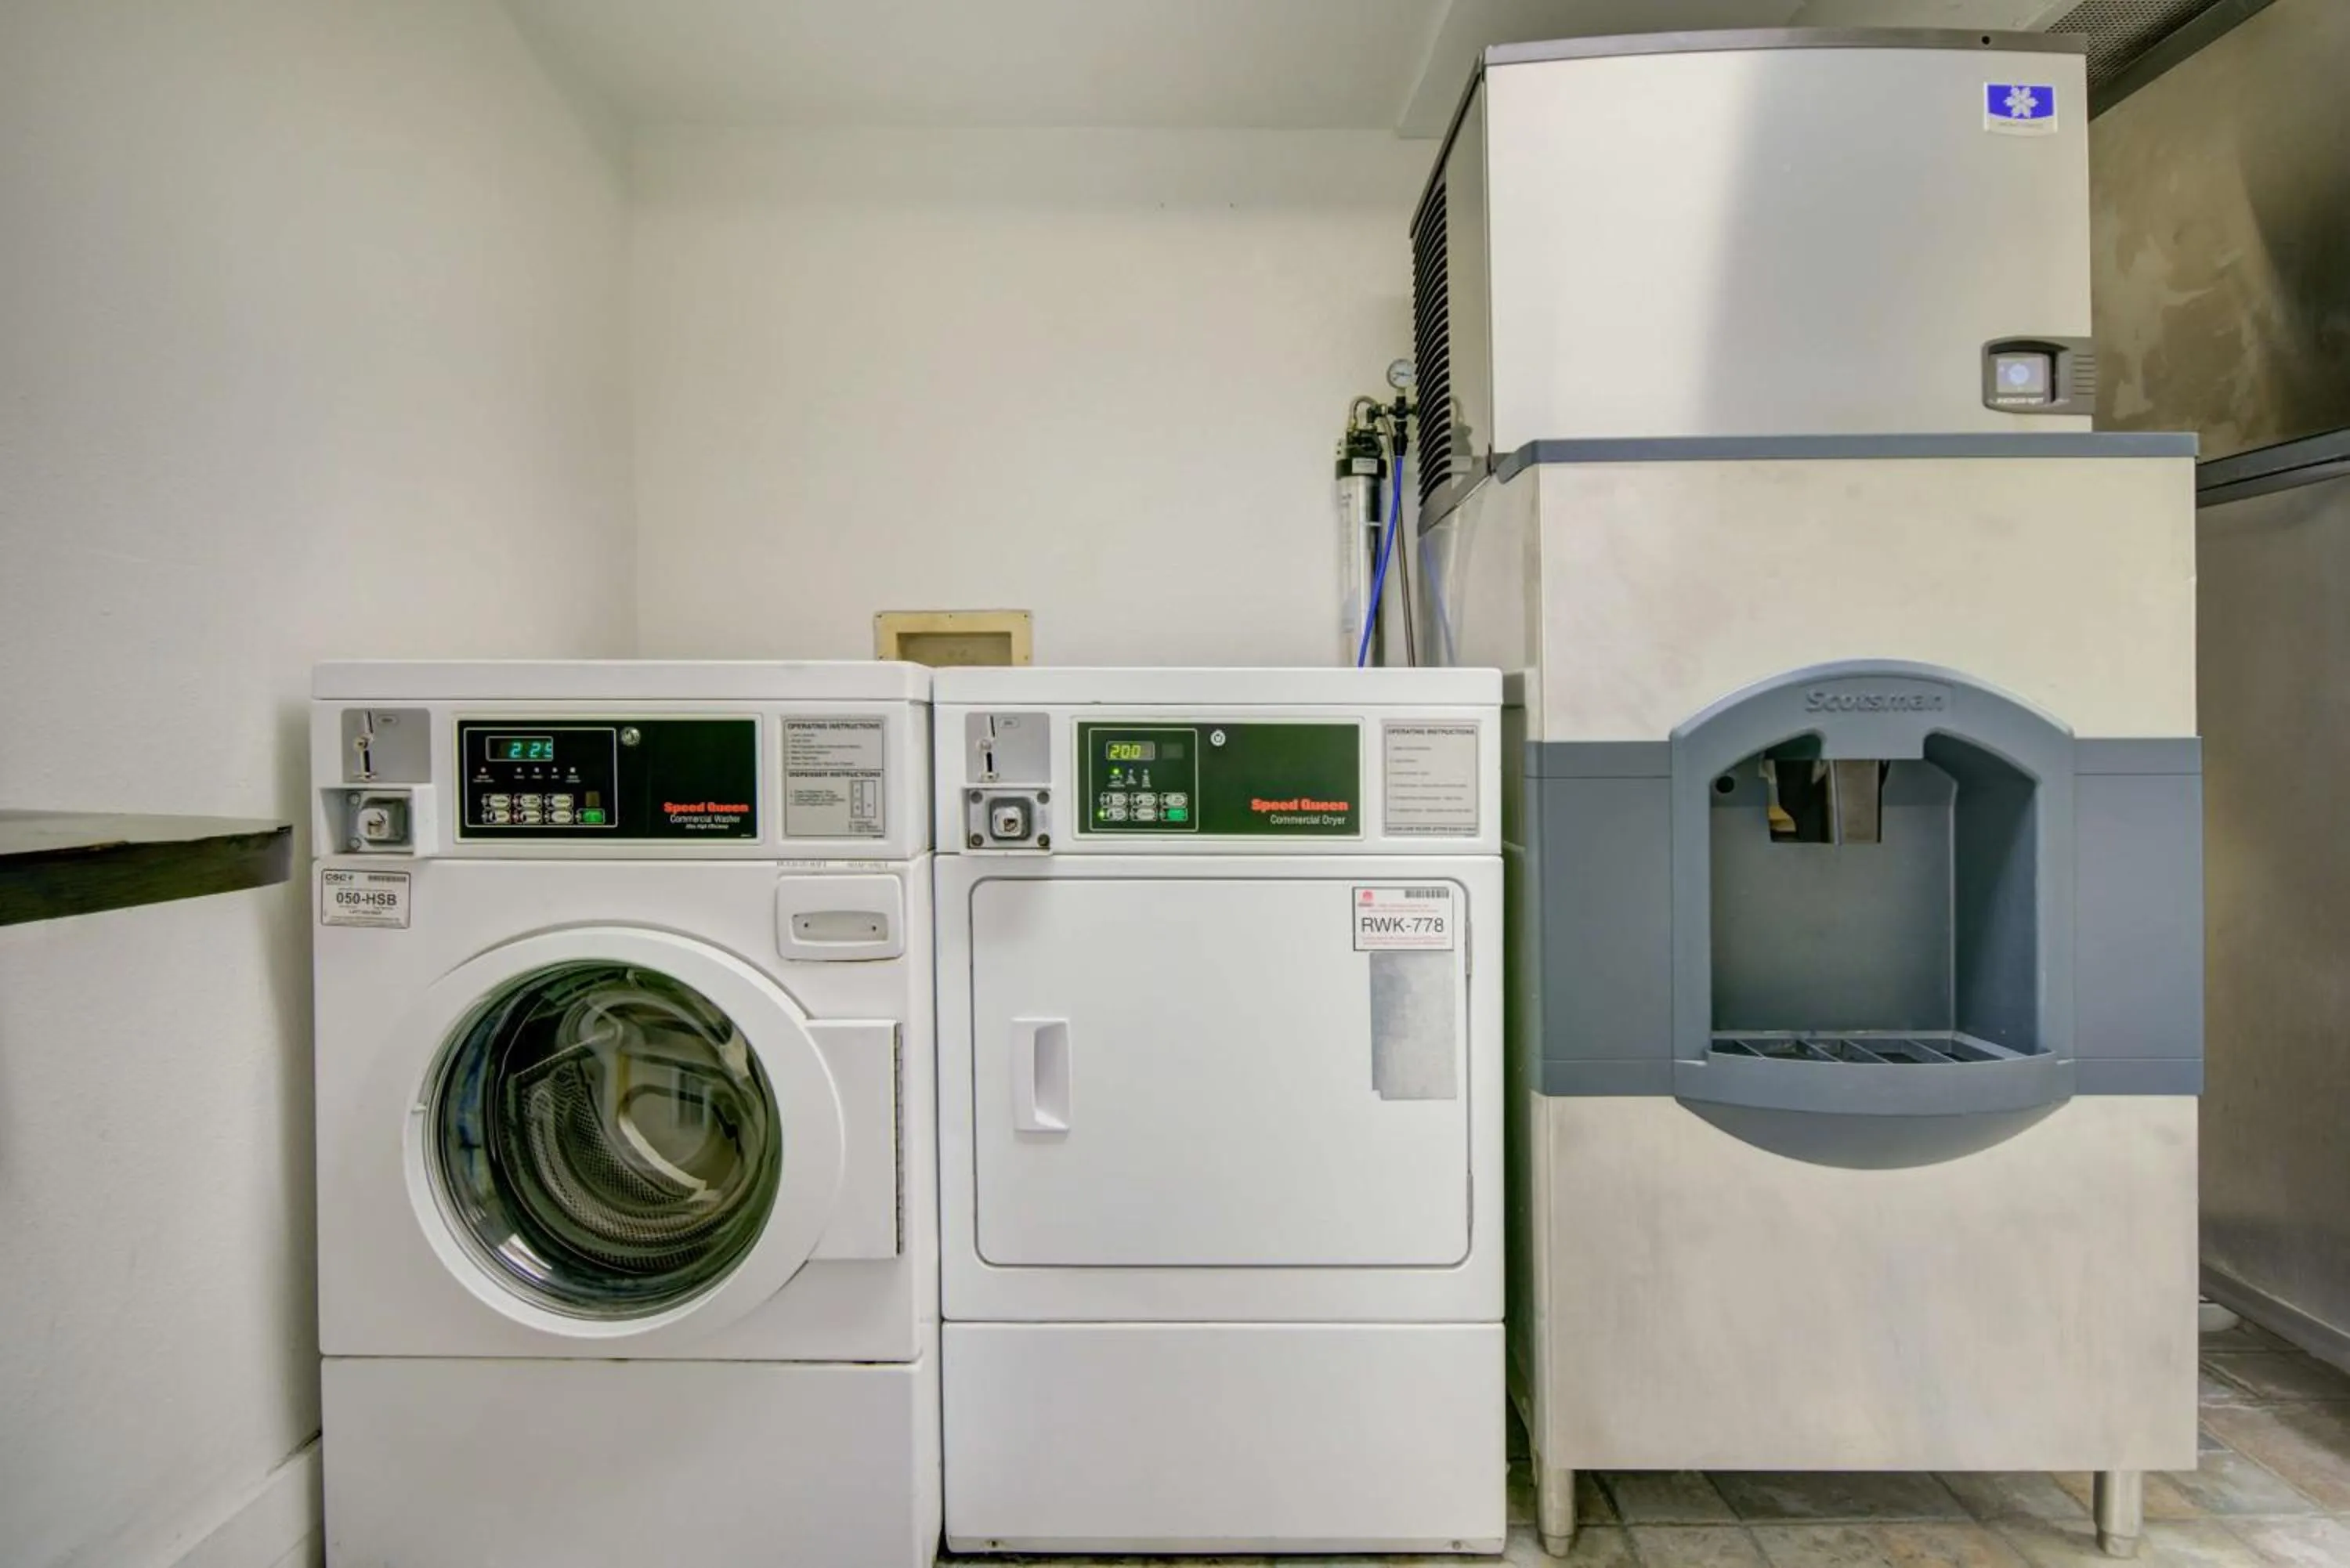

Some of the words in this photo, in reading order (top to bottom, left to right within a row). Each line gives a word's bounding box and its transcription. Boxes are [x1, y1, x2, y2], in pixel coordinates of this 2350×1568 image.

[1805, 692, 1943, 713] Scotsman
[1109, 743, 1141, 759] 200
[663, 801, 705, 815] Speed
[707, 801, 749, 812] Queen
[1252, 799, 1298, 813] Speed
[1300, 799, 1348, 811] Queen
[670, 815, 712, 823] Commercial
[714, 815, 740, 823] Washer
[1270, 815, 1320, 825] Commercial
[1321, 815, 1346, 826] Dryer
[336, 892, 397, 905] 050-HSB
[1361, 916, 1444, 933] RWK-778
